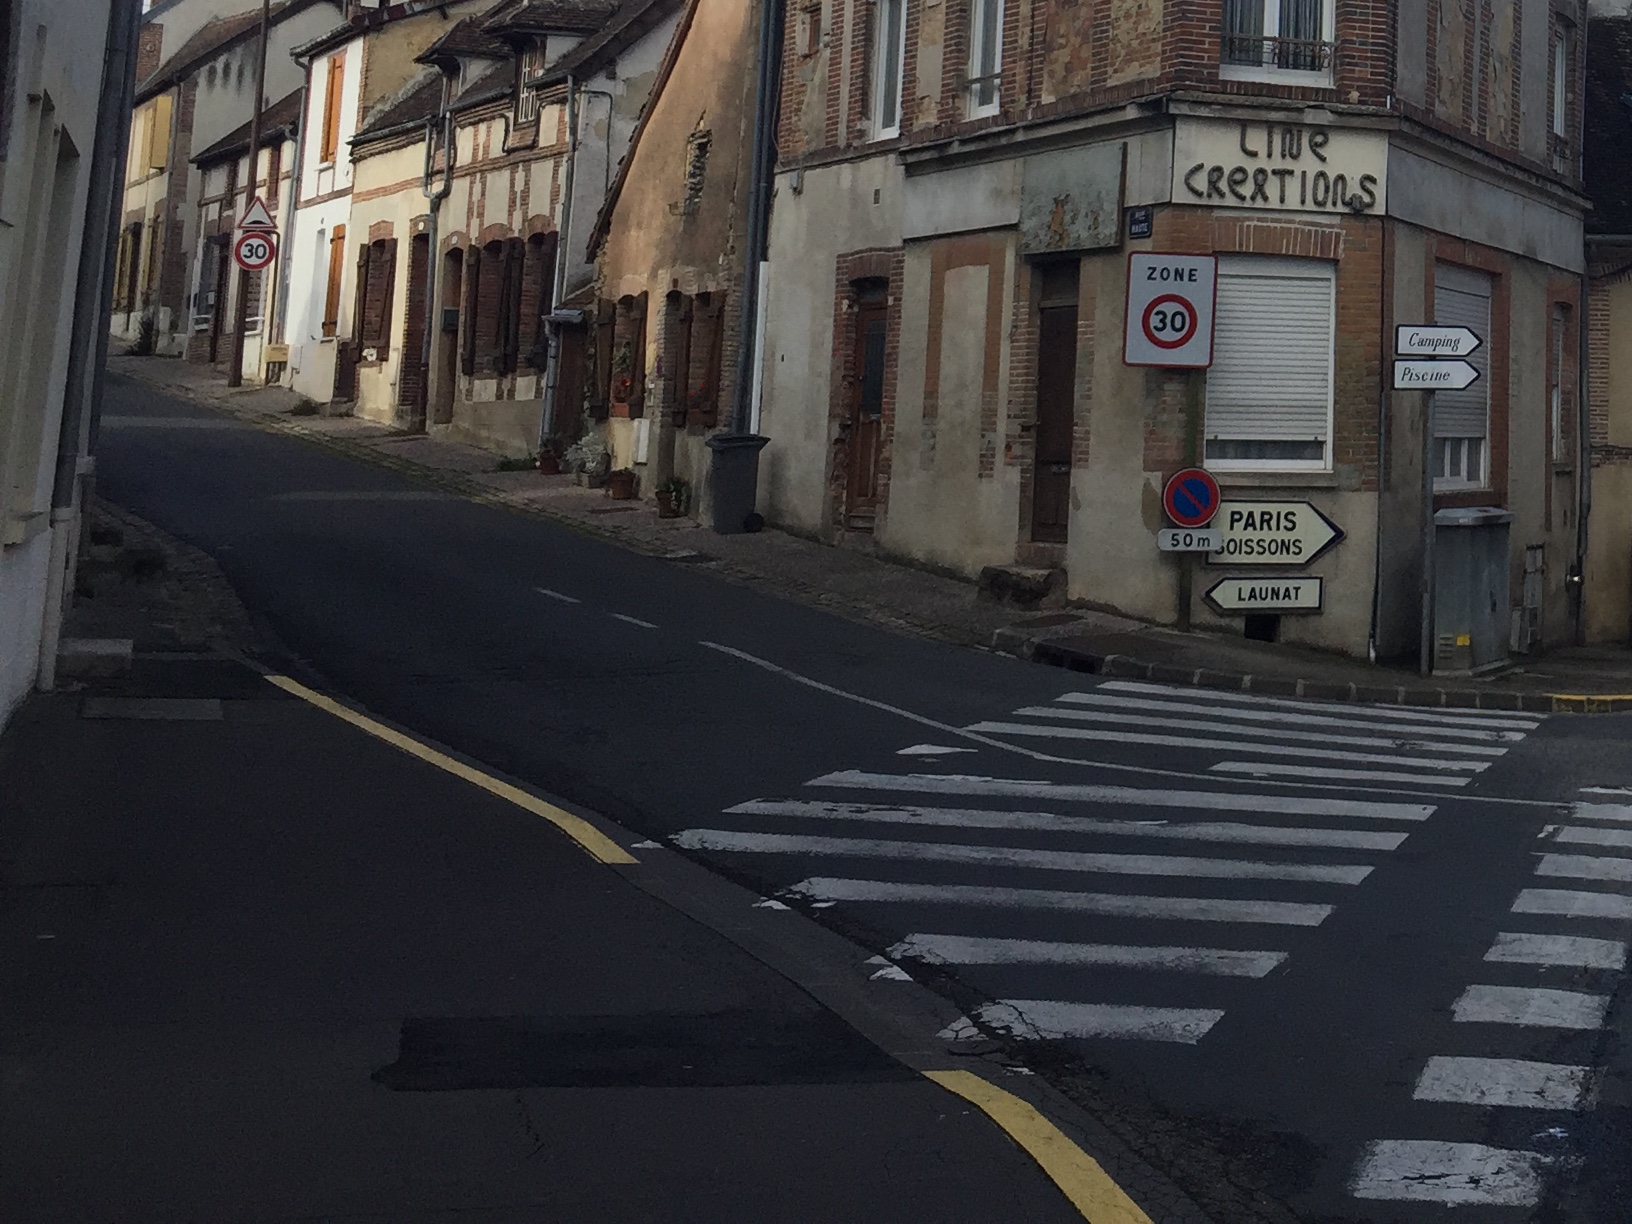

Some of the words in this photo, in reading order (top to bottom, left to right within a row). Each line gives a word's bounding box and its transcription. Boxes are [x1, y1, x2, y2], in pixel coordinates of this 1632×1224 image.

[243, 243, 267, 260] 30
[1147, 266, 1198, 282] ZONE
[1153, 310, 1187, 333] 30
[1408, 332, 1461, 352] Camping
[1401, 367, 1451, 382] Piscine
[1229, 510, 1297, 532] PARIS
[1238, 586, 1302, 602] LAUNAT
